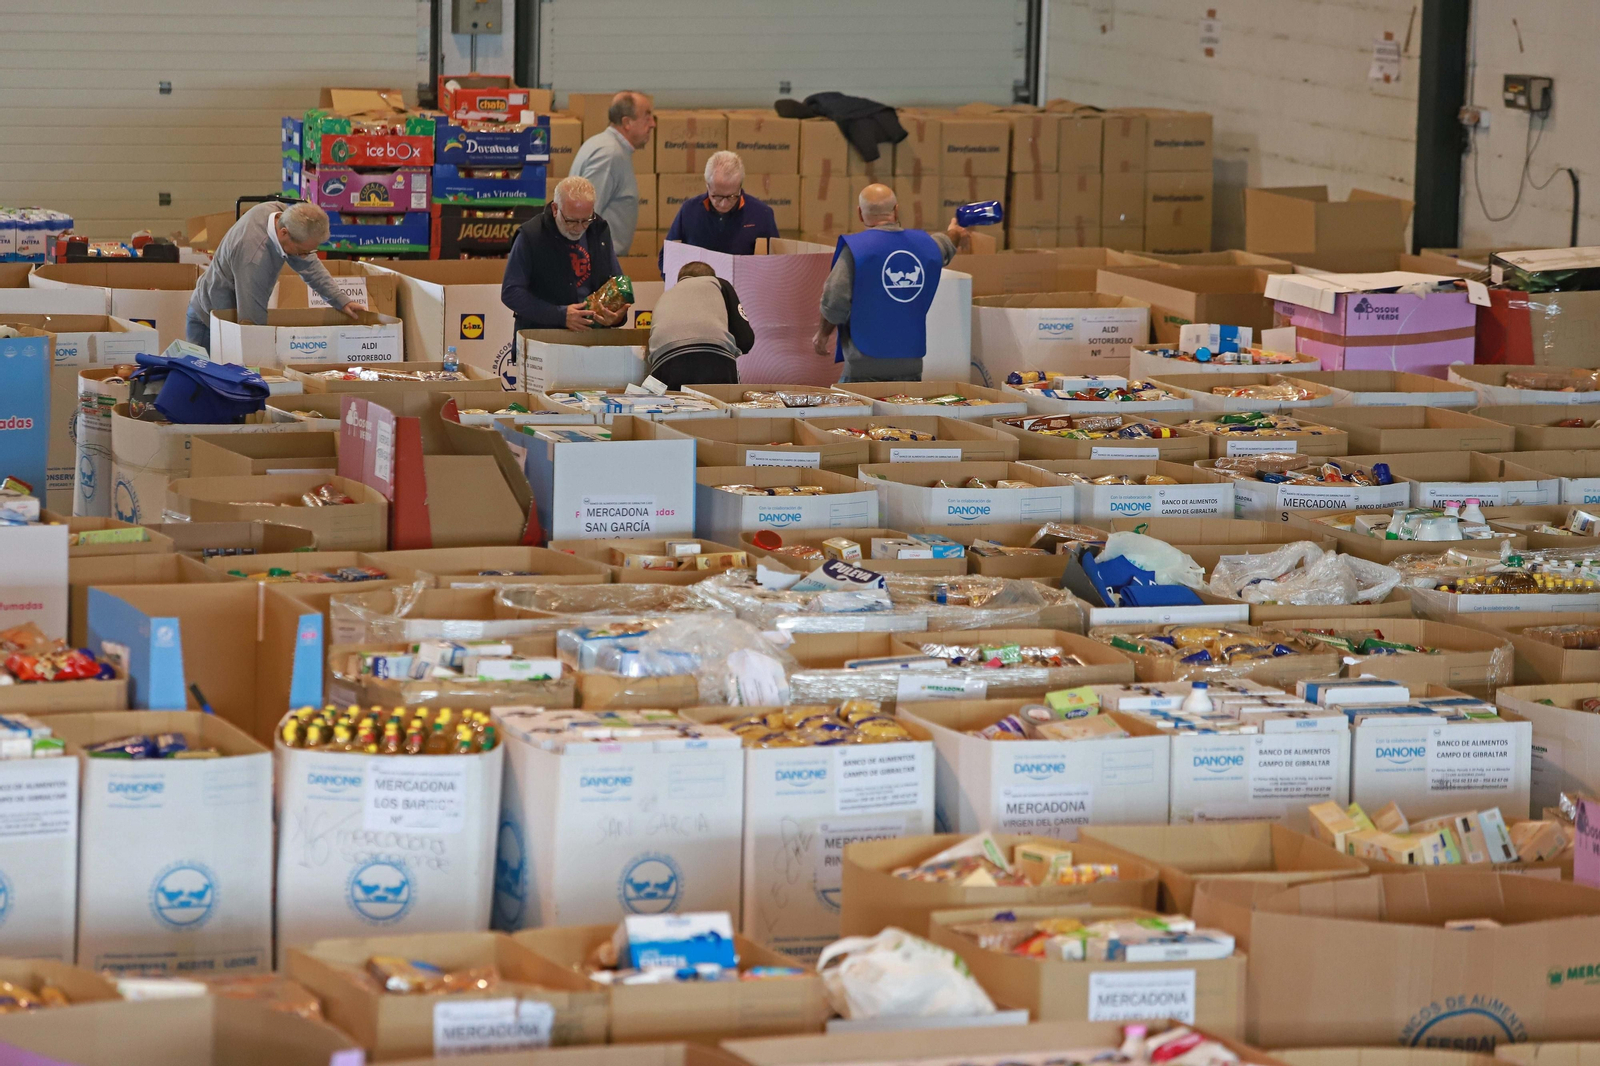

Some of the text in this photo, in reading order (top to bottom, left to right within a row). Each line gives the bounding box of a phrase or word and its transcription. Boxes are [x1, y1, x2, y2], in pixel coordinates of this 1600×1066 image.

[479, 99, 507, 111] chata
[366, 142, 384, 157] ice
[736, 142, 790, 151] Ebrofundación
[477, 190, 527, 199] Las Virtudes
[359, 236, 410, 246] Las Virtudes
[1365, 302, 1399, 314] BOSQUE
[361, 342, 378, 350] ALDI
[347, 354, 392, 362] SOTOREBOLO
[1110, 502, 1152, 511] DANONE
[1283, 498, 1347, 509] MERCADONA
[586, 507, 649, 517] MERCADONA
[948, 506, 991, 515] DANONE
[759, 513, 802, 522] DANONE
[585, 520, 650, 532] SAN GARCÍA
[828, 561, 873, 581] PULEVA
[927, 684, 965, 693] MERCADONA
[1376, 746, 1426, 758] DANONE
[1193, 754, 1244, 767] DANONE
[1014, 762, 1066, 774] DANONE
[374, 779, 456, 792] MERCADONA
[374, 797, 399, 809] LOS
[1006, 801, 1086, 814] MERCADONA
[1003, 816, 1089, 828] VIRGEN DEL CARMEN
[1098, 992, 1187, 1007] MERCADONA
[1446, 994, 1466, 1010] DE
